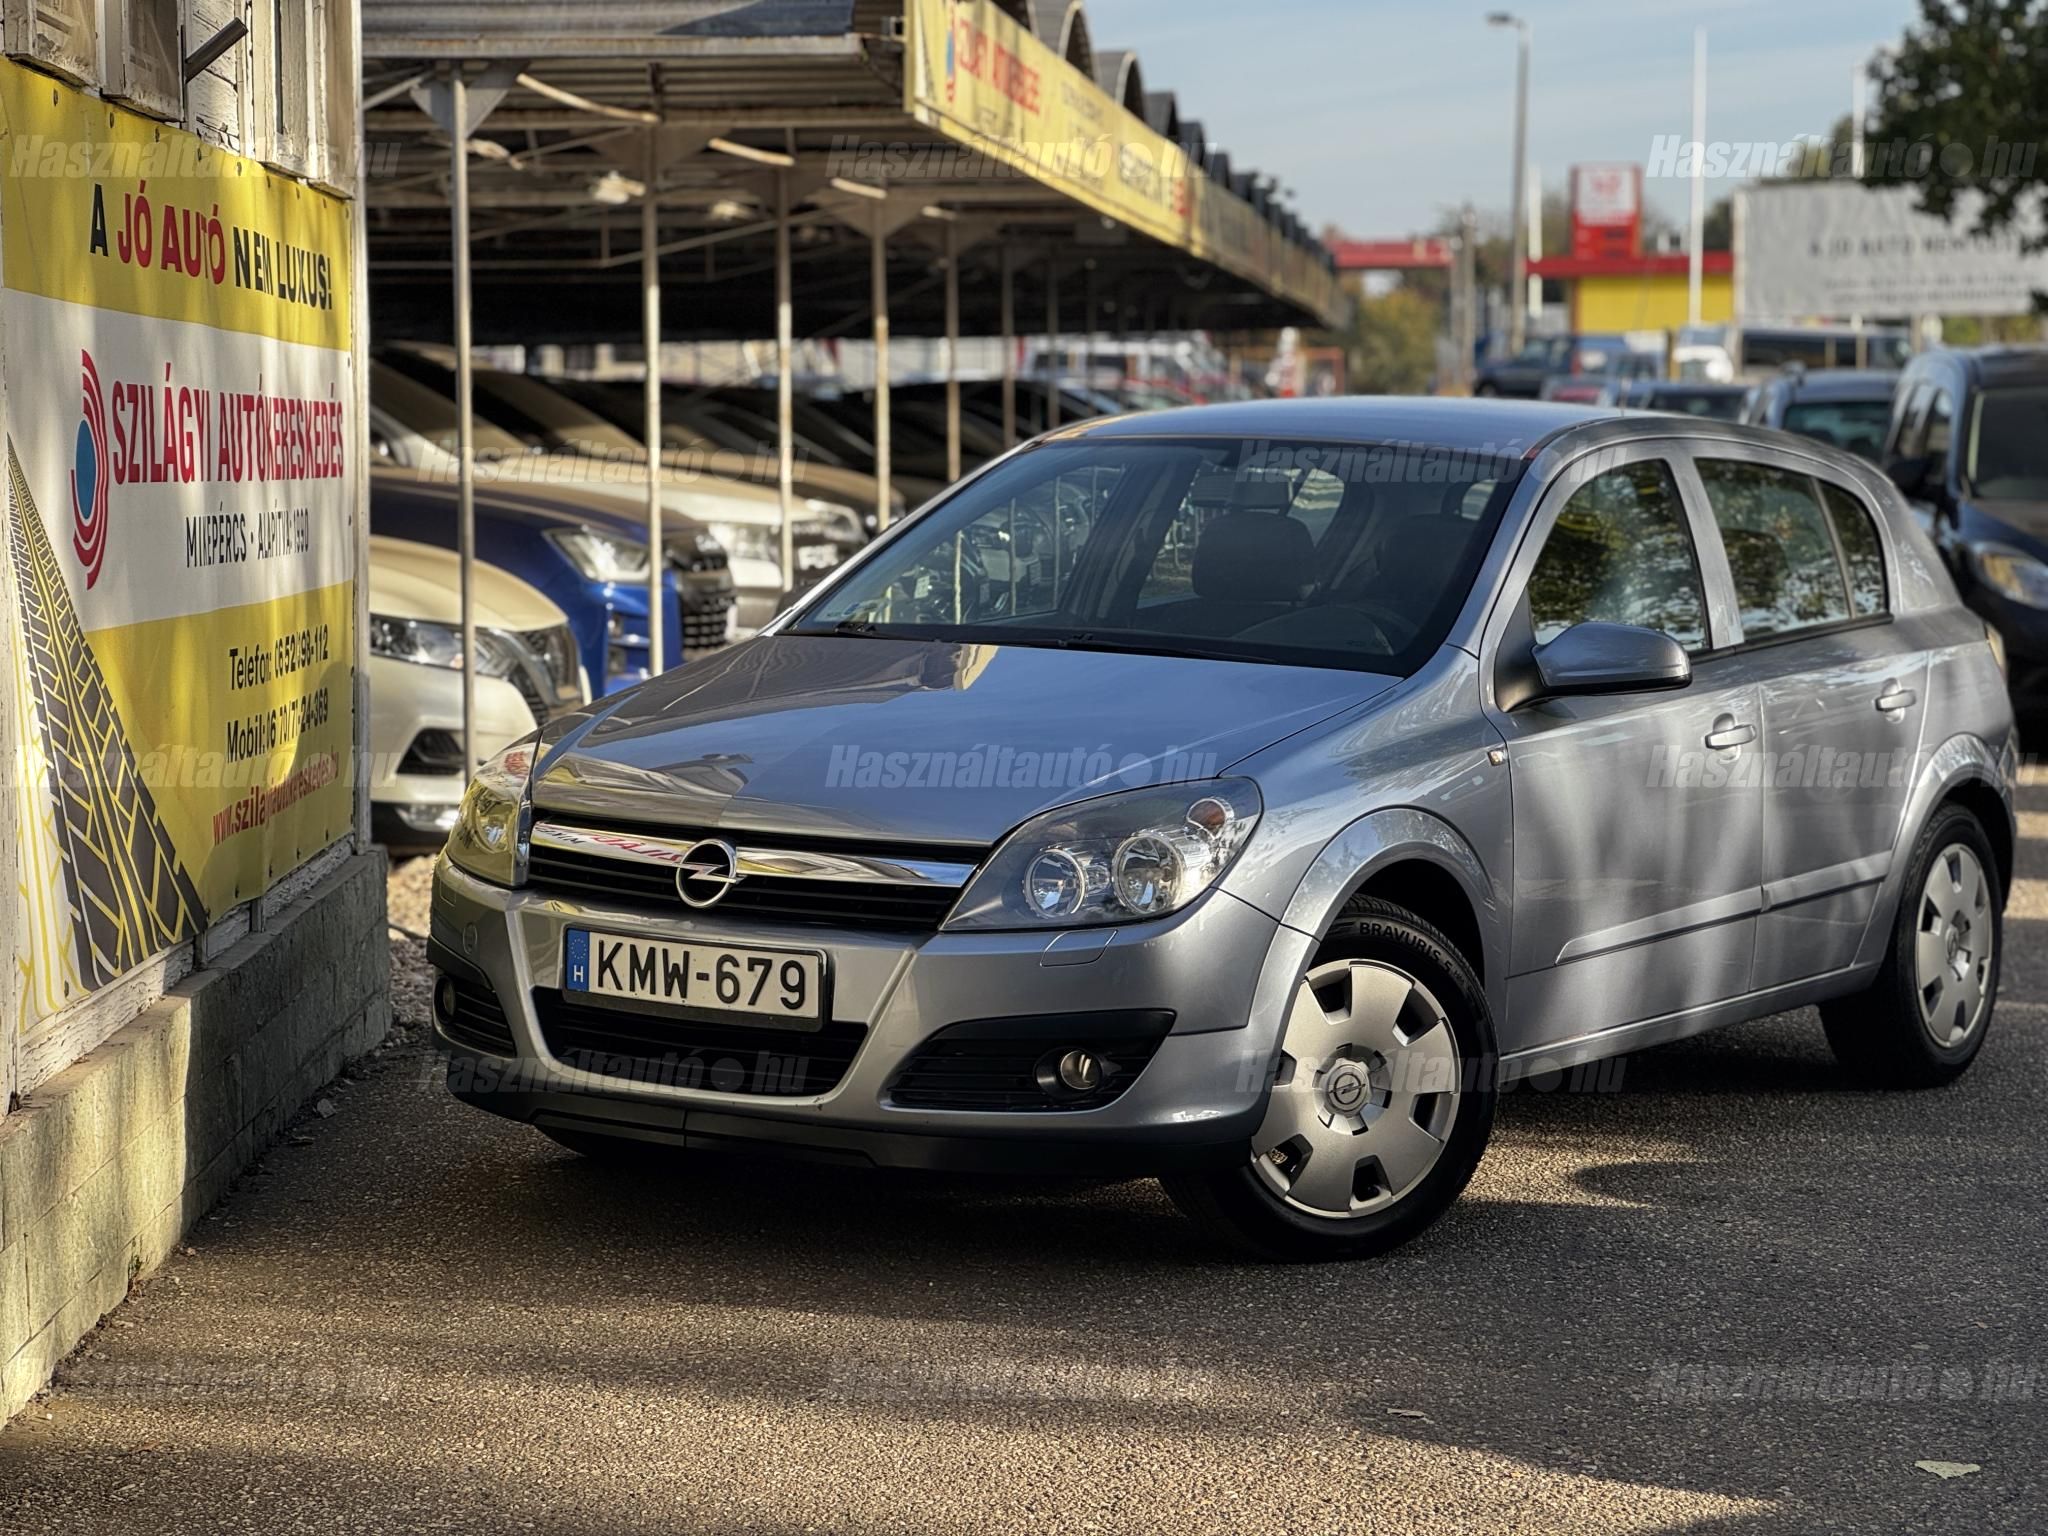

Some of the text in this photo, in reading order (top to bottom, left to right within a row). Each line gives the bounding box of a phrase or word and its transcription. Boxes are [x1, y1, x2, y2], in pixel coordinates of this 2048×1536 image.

[90, 180, 333, 311] A JÓ AUTÓ NEM LUXUS!
[112, 362, 344, 485] SZILÁGYI AUTÓKERESKEDÉS
[186, 500, 247, 569] MIKEPÉRCS
[227, 713, 265, 764] Mobil:
[573, 939, 806, 1011] H KMW-679
[1359, 922, 1442, 961] BRAVURIS
[1444, 960, 1453, 973] 5
